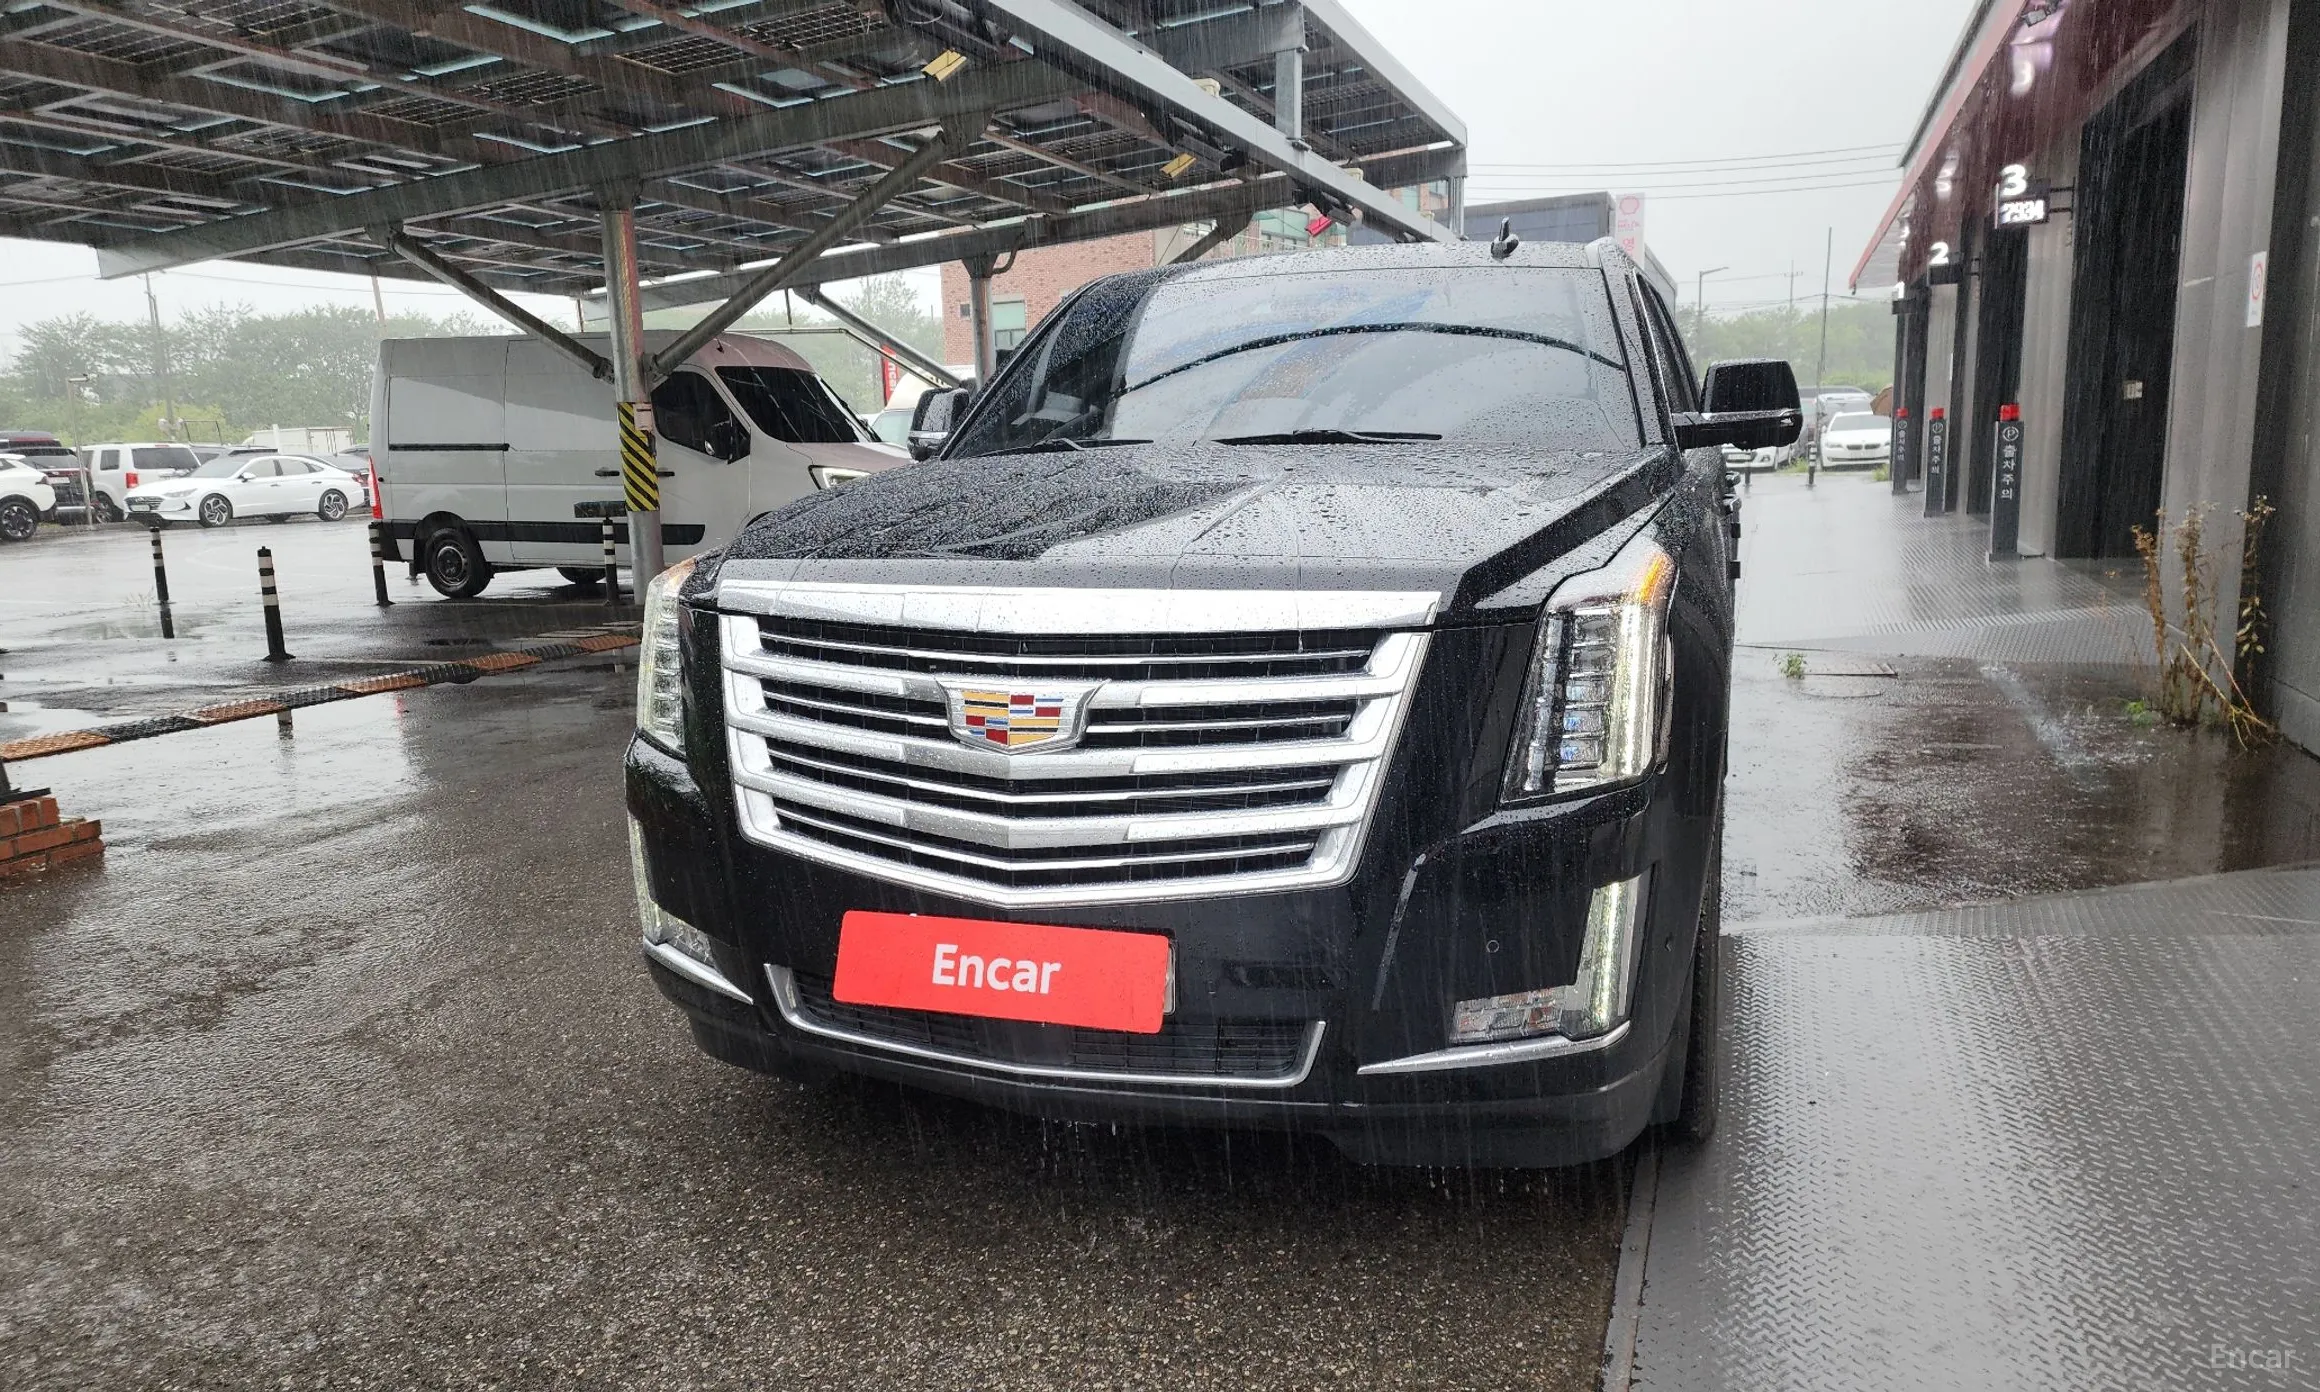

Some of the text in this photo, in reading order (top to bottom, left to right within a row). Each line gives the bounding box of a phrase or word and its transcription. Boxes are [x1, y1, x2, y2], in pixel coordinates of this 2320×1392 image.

[2001, 164, 2027, 196] 3
[1930, 241, 1950, 266] 2
[1894, 281, 1905, 299] 1
[2002, 445, 2016, 499] 출차주의
[932, 943, 1061, 995] Encar
